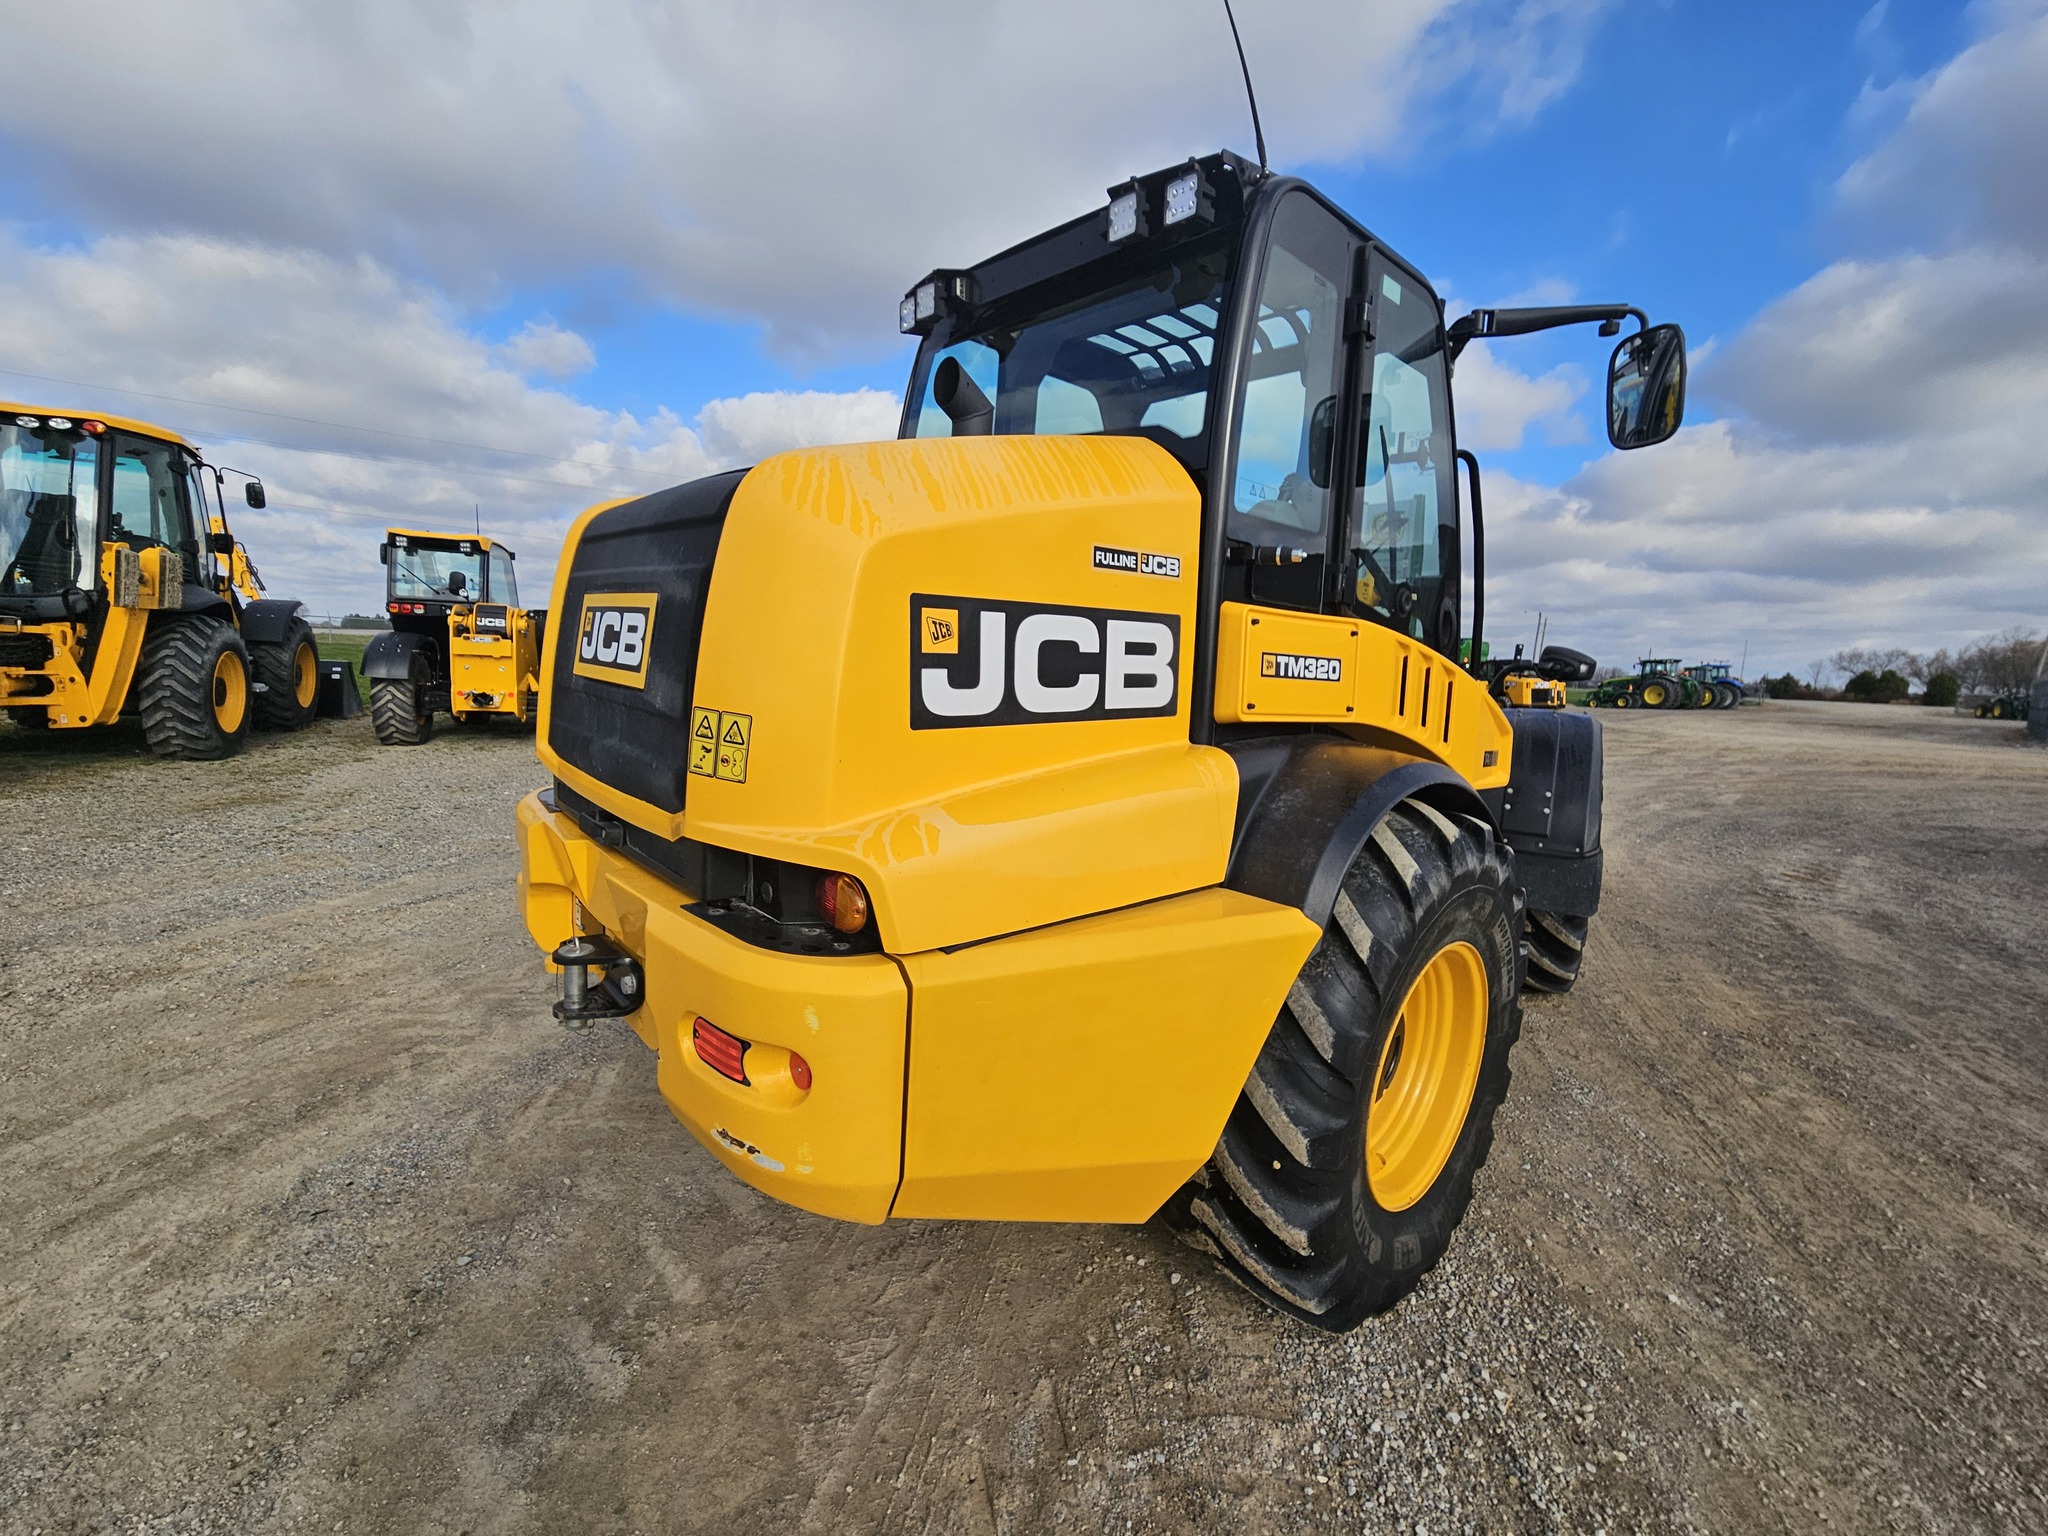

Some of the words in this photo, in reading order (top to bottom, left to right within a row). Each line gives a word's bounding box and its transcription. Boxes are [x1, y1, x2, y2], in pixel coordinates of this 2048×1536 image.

[1095, 550, 1137, 569] FULLINE
[1141, 554, 1180, 577] JCB
[476, 616, 506, 628] JCB
[930, 617, 954, 642] JCB
[581, 610, 647, 667] JCB
[920, 610, 1175, 718] JCB
[1276, 654, 1341, 681] TM320
